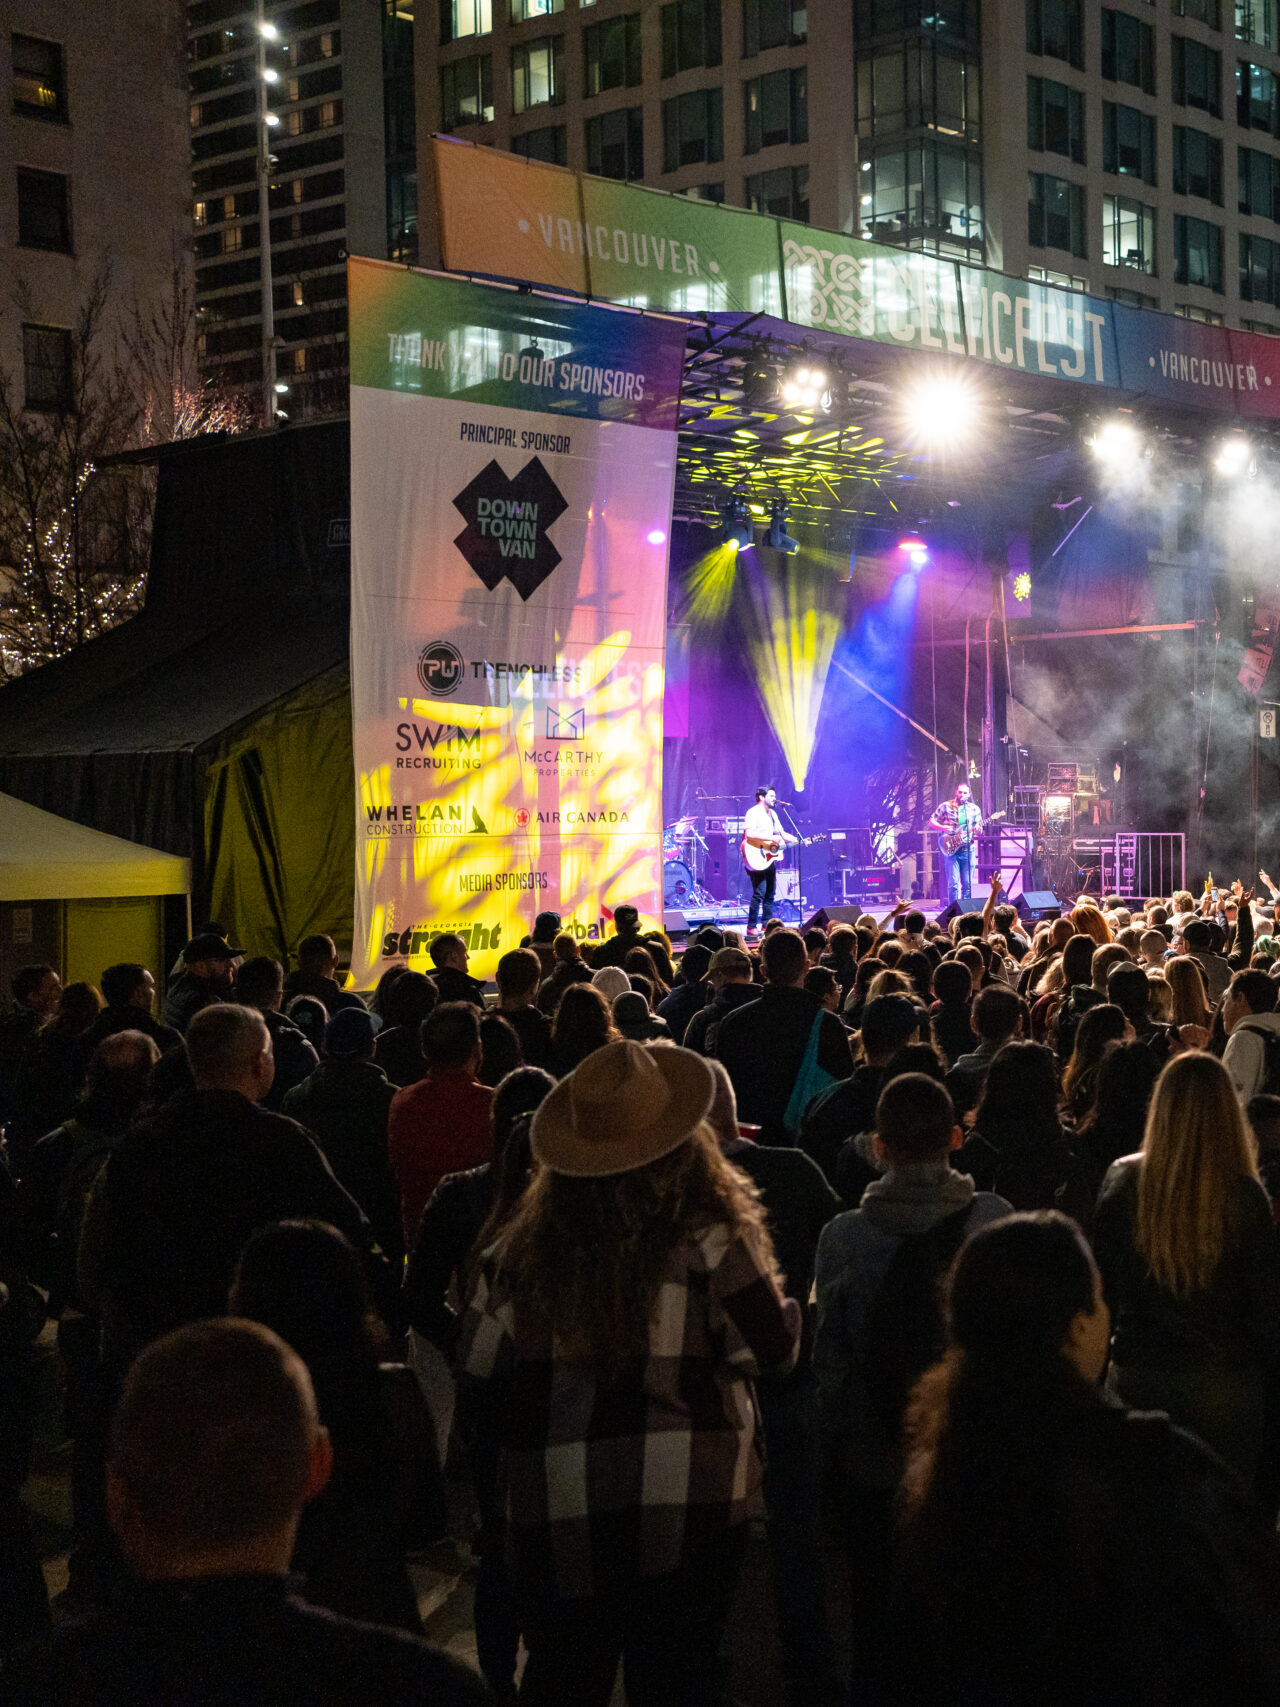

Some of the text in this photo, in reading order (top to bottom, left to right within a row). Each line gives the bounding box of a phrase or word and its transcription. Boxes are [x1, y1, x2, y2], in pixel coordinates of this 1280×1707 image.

[538, 212, 700, 277] VANCOUVER
[887, 265, 1105, 382] CELTICFEST
[519, 355, 555, 389] OUR
[559, 362, 645, 401] SPONSORS
[1159, 349, 1259, 391] VANCOUVER
[460, 422, 571, 454] PRINCIPAL SPONSOR
[477, 497, 538, 521] DOWN
[477, 517, 537, 540] TOWN
[499, 538, 536, 559] VAN
[470, 661, 583, 683] TRENCHLESS
[395, 723, 481, 753] SWIM
[396, 757, 482, 769] RECRUITING
[524, 750, 604, 764] McCARTHY
[533, 768, 596, 777] PROPERTIES
[366, 805, 462, 822] WHELAN
[536, 811, 630, 823] AIR CANADA
[366, 823, 463, 836] CONSTRUCTION
[459, 872, 548, 893] MEDIA SPONSORS
[382, 922, 502, 956] strht
